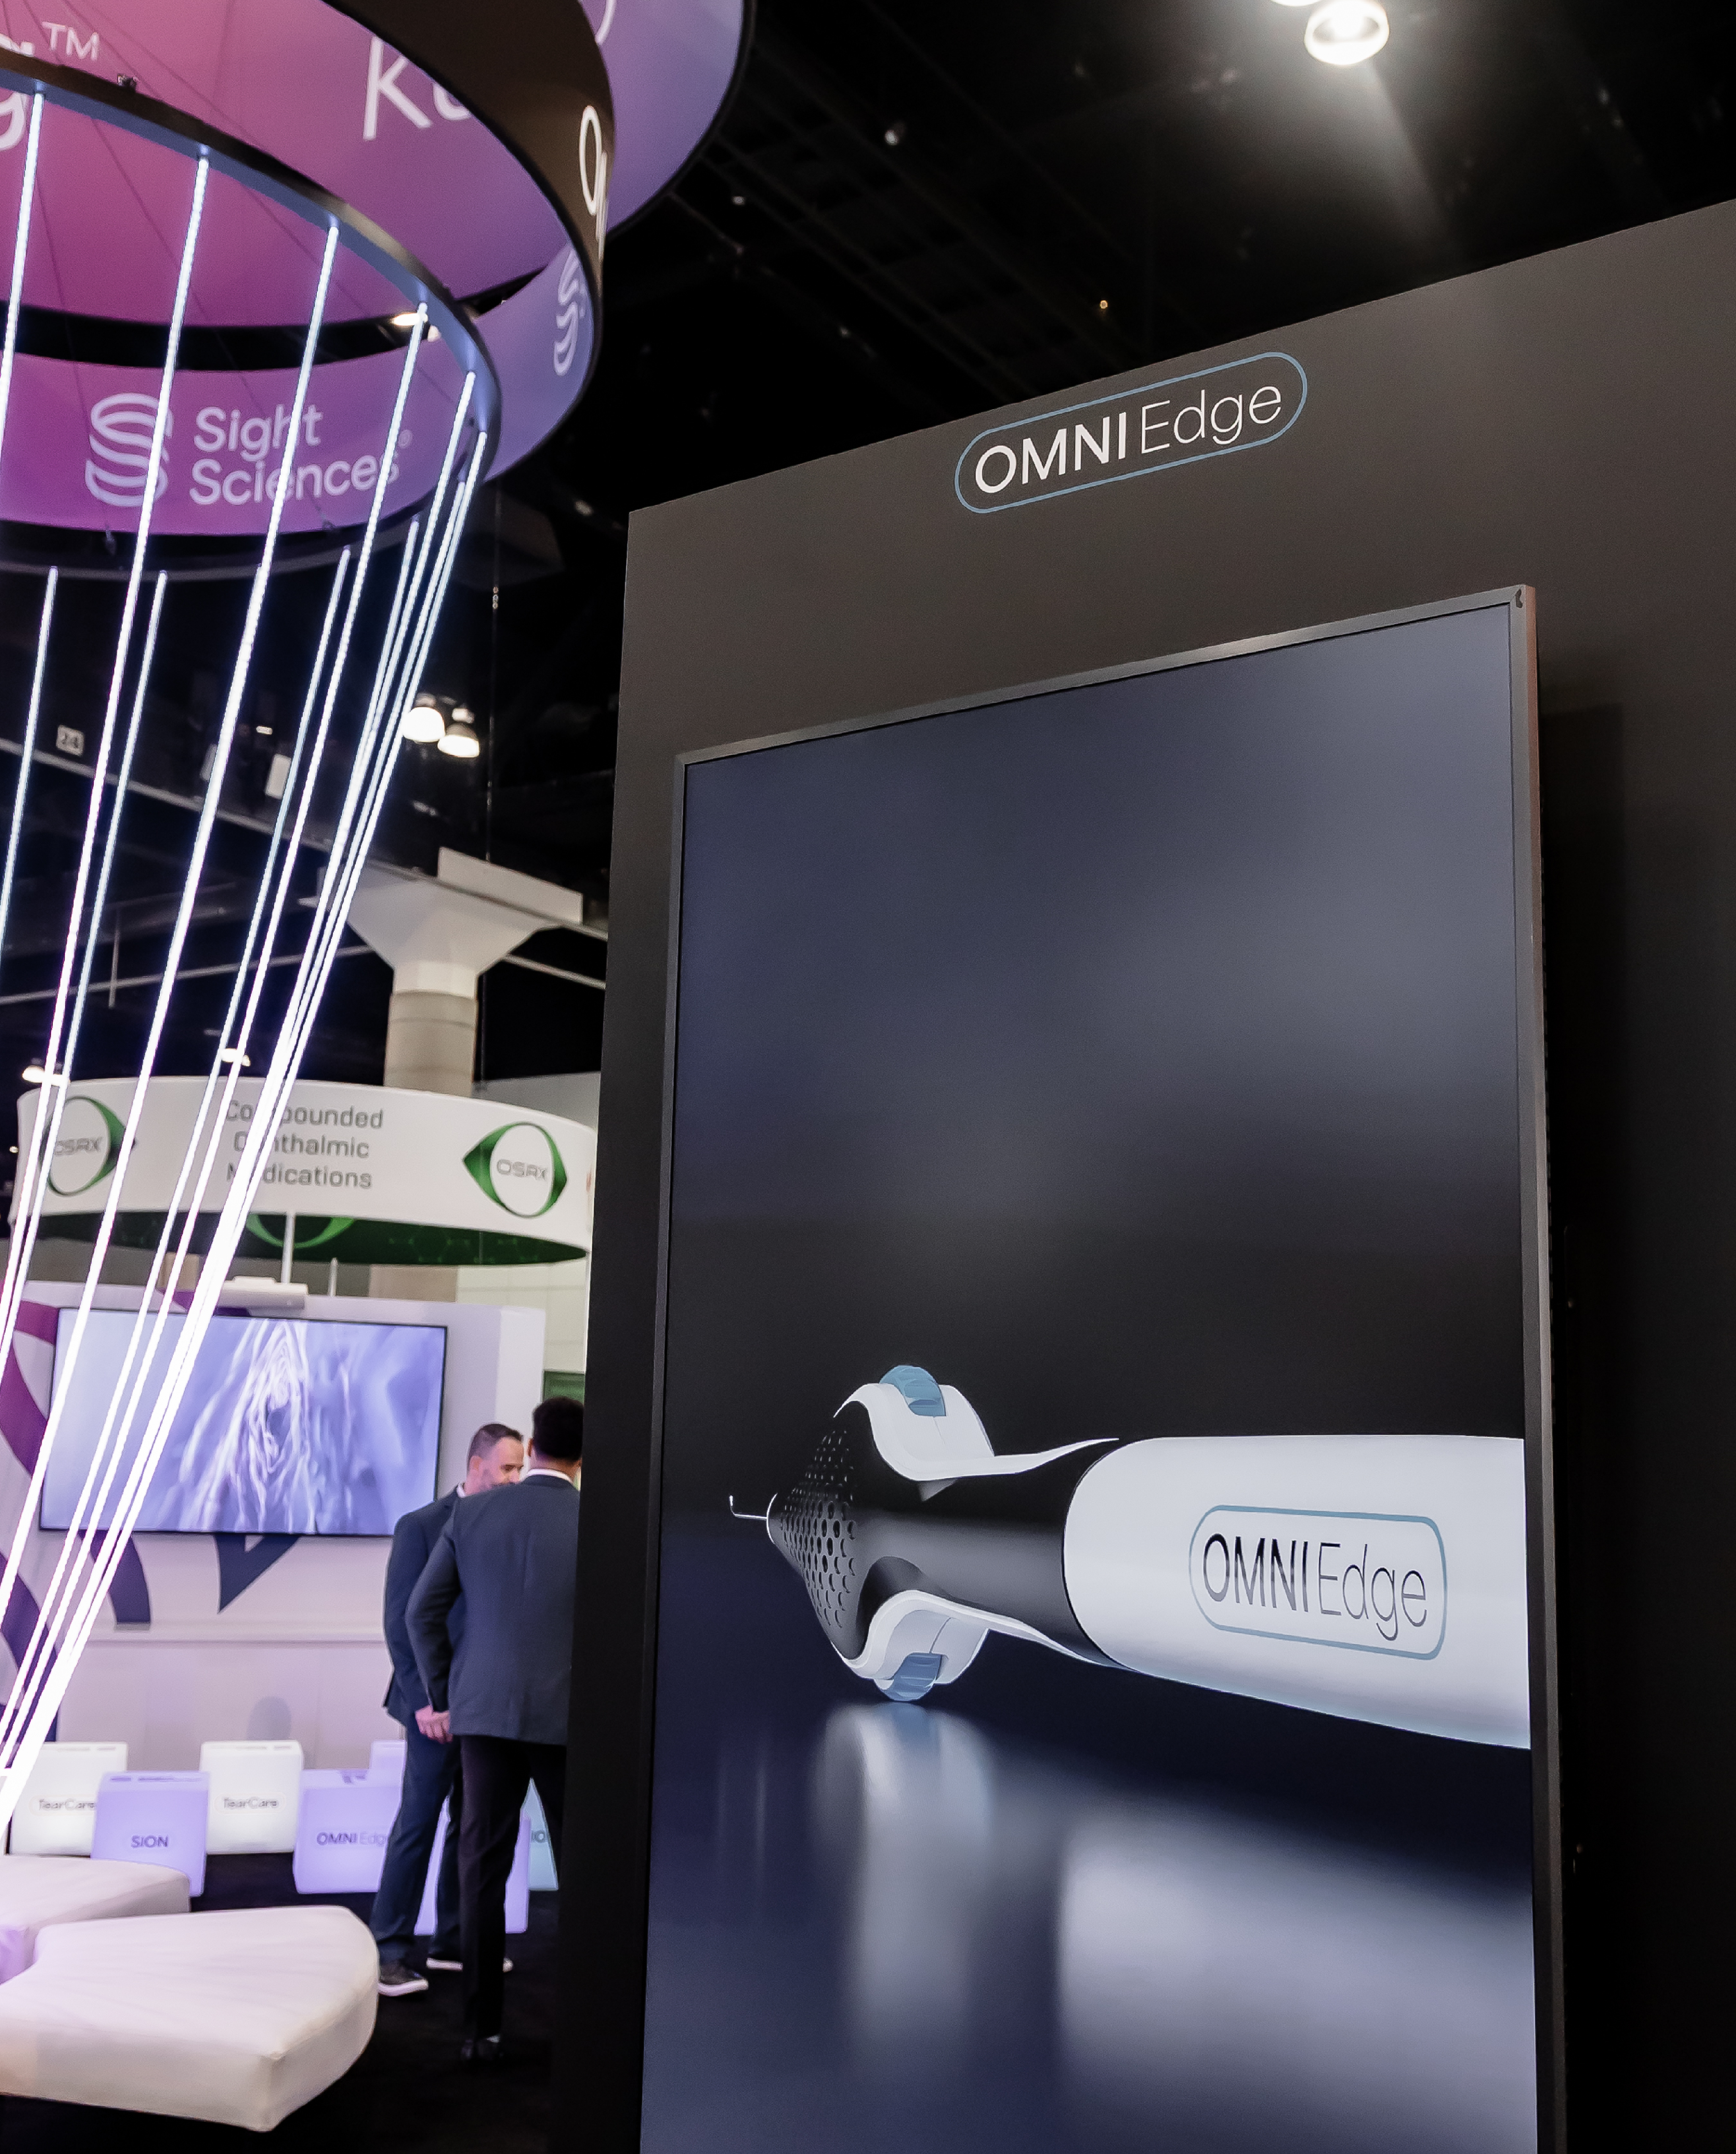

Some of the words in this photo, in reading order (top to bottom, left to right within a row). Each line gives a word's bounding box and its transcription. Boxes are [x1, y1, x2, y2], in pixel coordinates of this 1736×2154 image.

[194, 404, 324, 462] Sight
[975, 412, 1126, 494] OMNI
[1141, 386, 1281, 454] Edge
[226, 1100, 383, 1129] Copounded
[234, 1131, 369, 1158] Othalmic
[226, 1162, 372, 1189] dications
[1203, 1533, 1309, 1612] OMNI
[1319, 1542, 1427, 1641] Edge
[131, 1835, 168, 1848] SION
[359, 1831, 387, 1847] Edg
